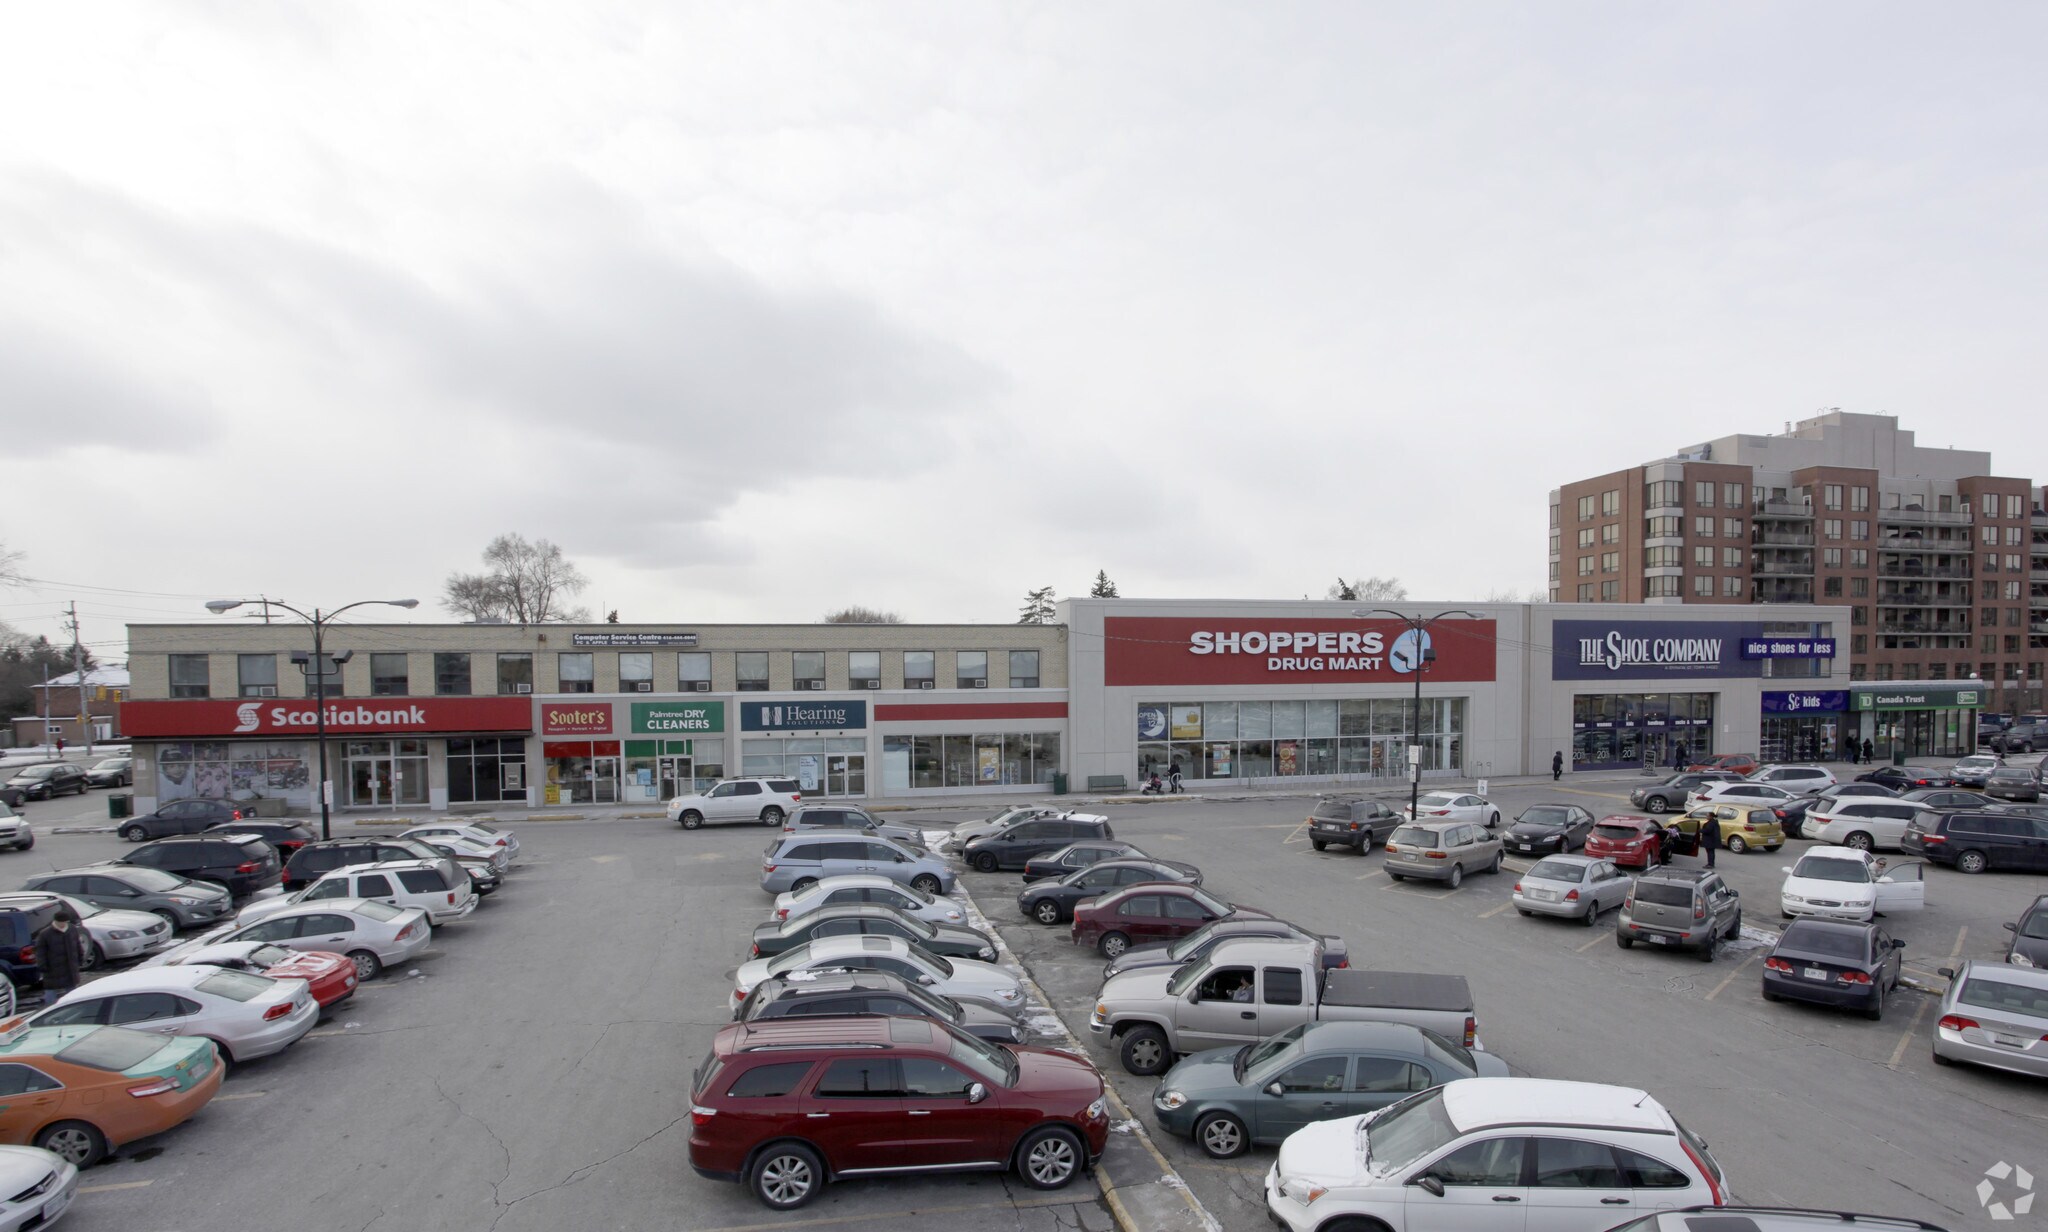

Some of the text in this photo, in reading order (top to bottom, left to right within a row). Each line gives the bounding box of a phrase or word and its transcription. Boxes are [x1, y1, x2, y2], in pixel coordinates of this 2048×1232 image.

[574, 634, 610, 642] Computer
[1188, 631, 1384, 655] SHOPPERS
[1579, 630, 1722, 671] THE SHOE COMPANY
[1748, 642, 1832, 654] nice shoes for less
[1267, 657, 1383, 671] DRUG MART
[1802, 695, 1821, 708] kids
[1861, 694, 1925, 707] TD Canada Trust
[271, 705, 426, 727] Scotiabank
[549, 709, 606, 726] Sooter's
[684, 709, 706, 718] DRY
[786, 704, 847, 725] Hearing
[646, 719, 710, 730] CLEANERS
